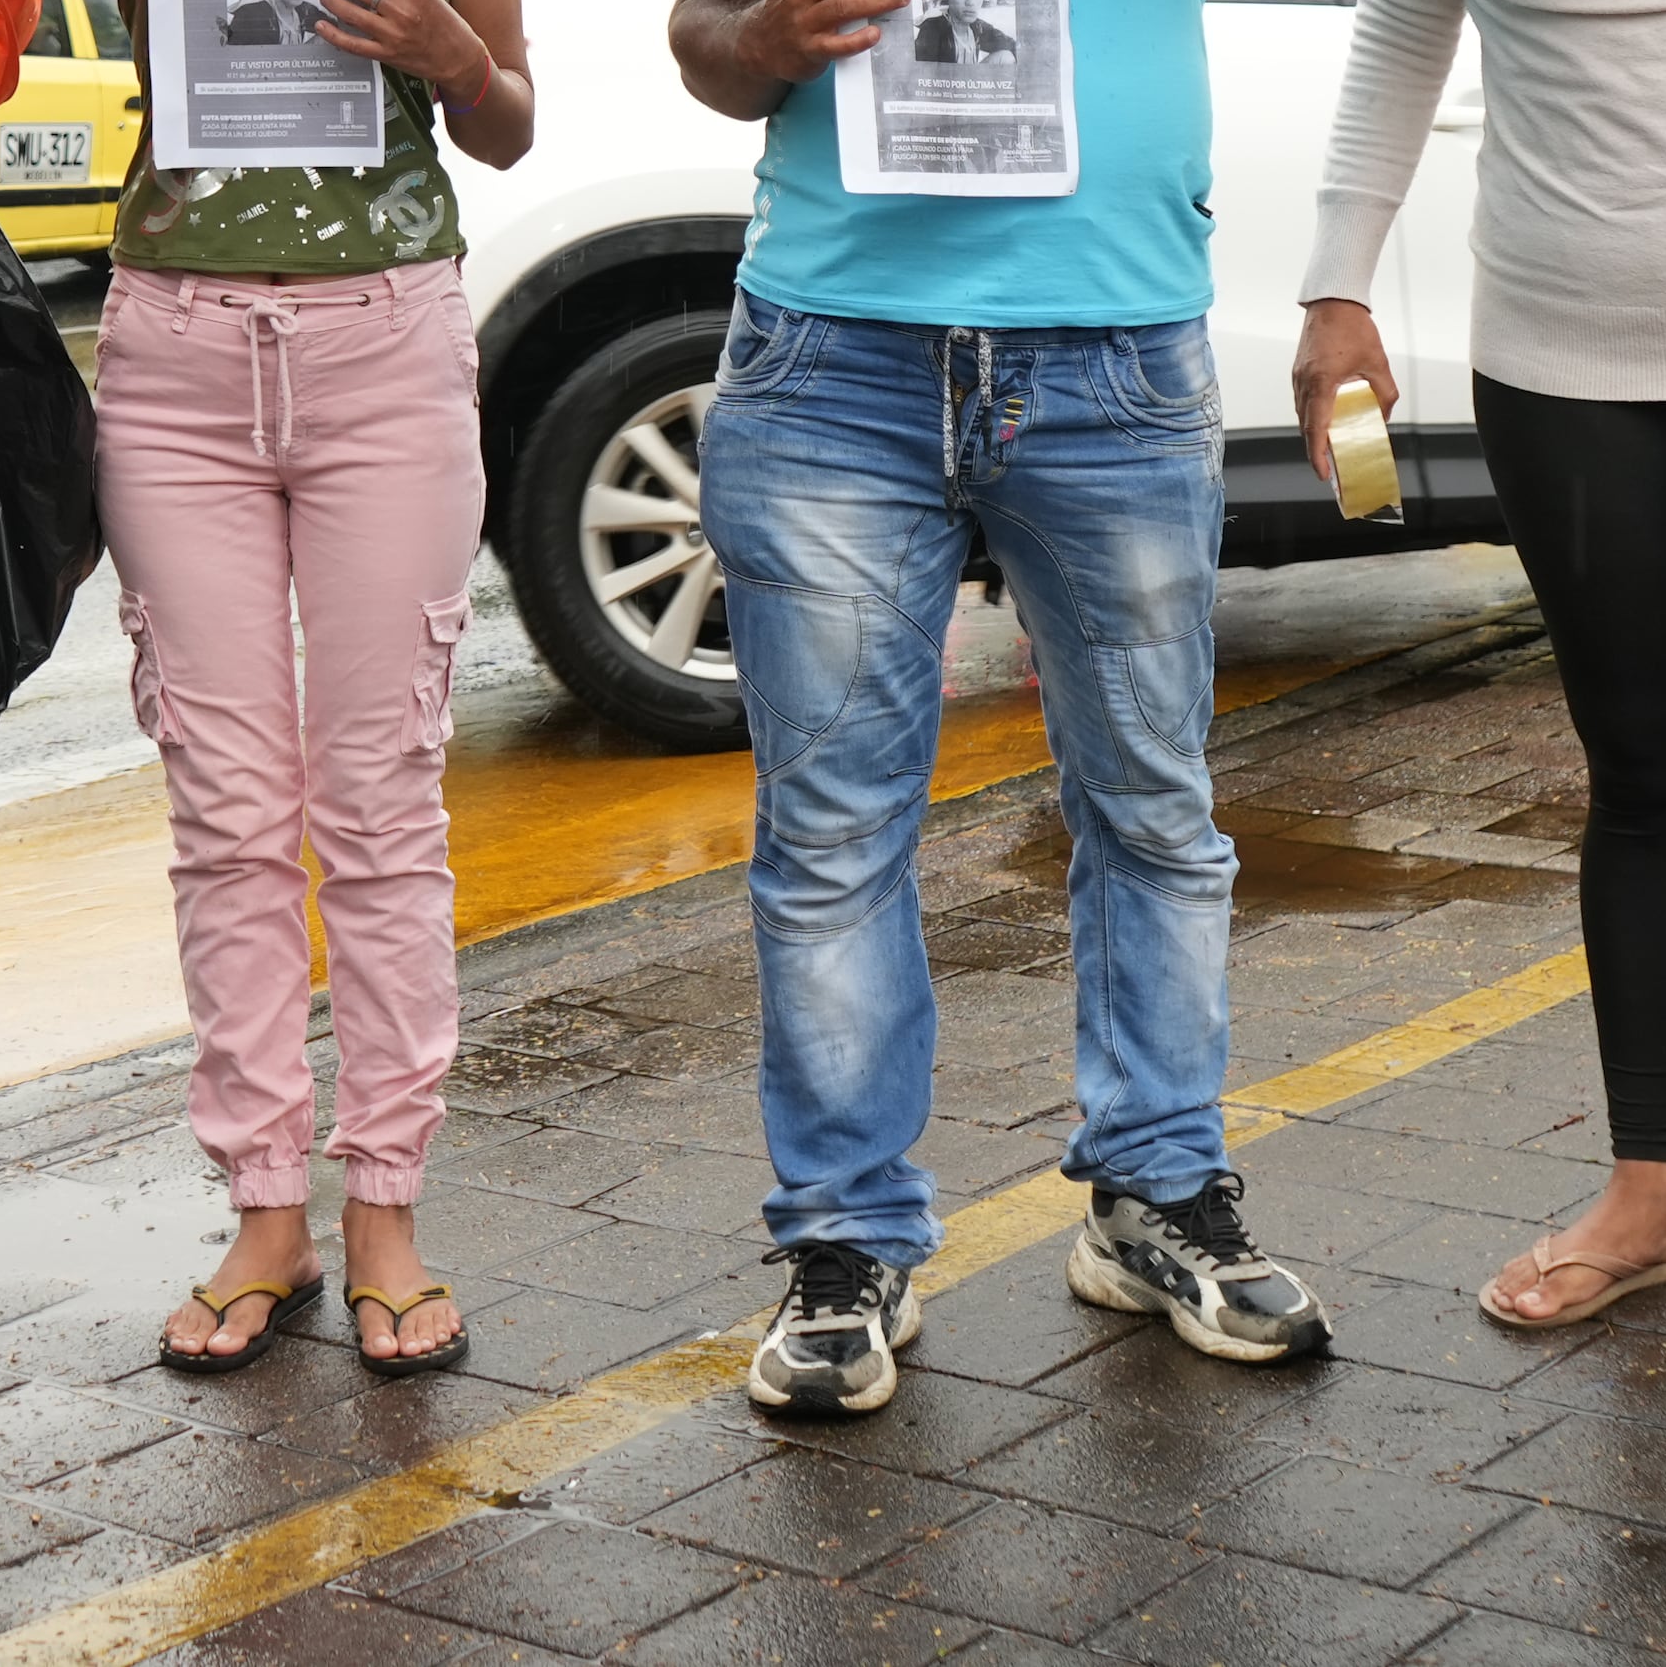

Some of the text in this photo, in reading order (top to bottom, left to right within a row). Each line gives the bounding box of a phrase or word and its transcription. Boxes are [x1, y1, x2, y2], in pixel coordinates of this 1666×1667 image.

[230, 61, 246, 70] FUE
[248, 61, 273, 69] VISTO
[274, 61, 291, 69] POR
[291, 59, 321, 69] ÚLTIMA
[918, 78, 932, 88] FUE
[932, 79, 951, 88] VISTO
[951, 80, 967, 89] POR
[967, 79, 997, 90] ÚLTIMA
[5, 133, 85, 167] SMU 312
[385, 141, 412, 160] CHANEL
[236, 202, 269, 224] CHANEL
[317, 220, 348, 241] CHANEL
